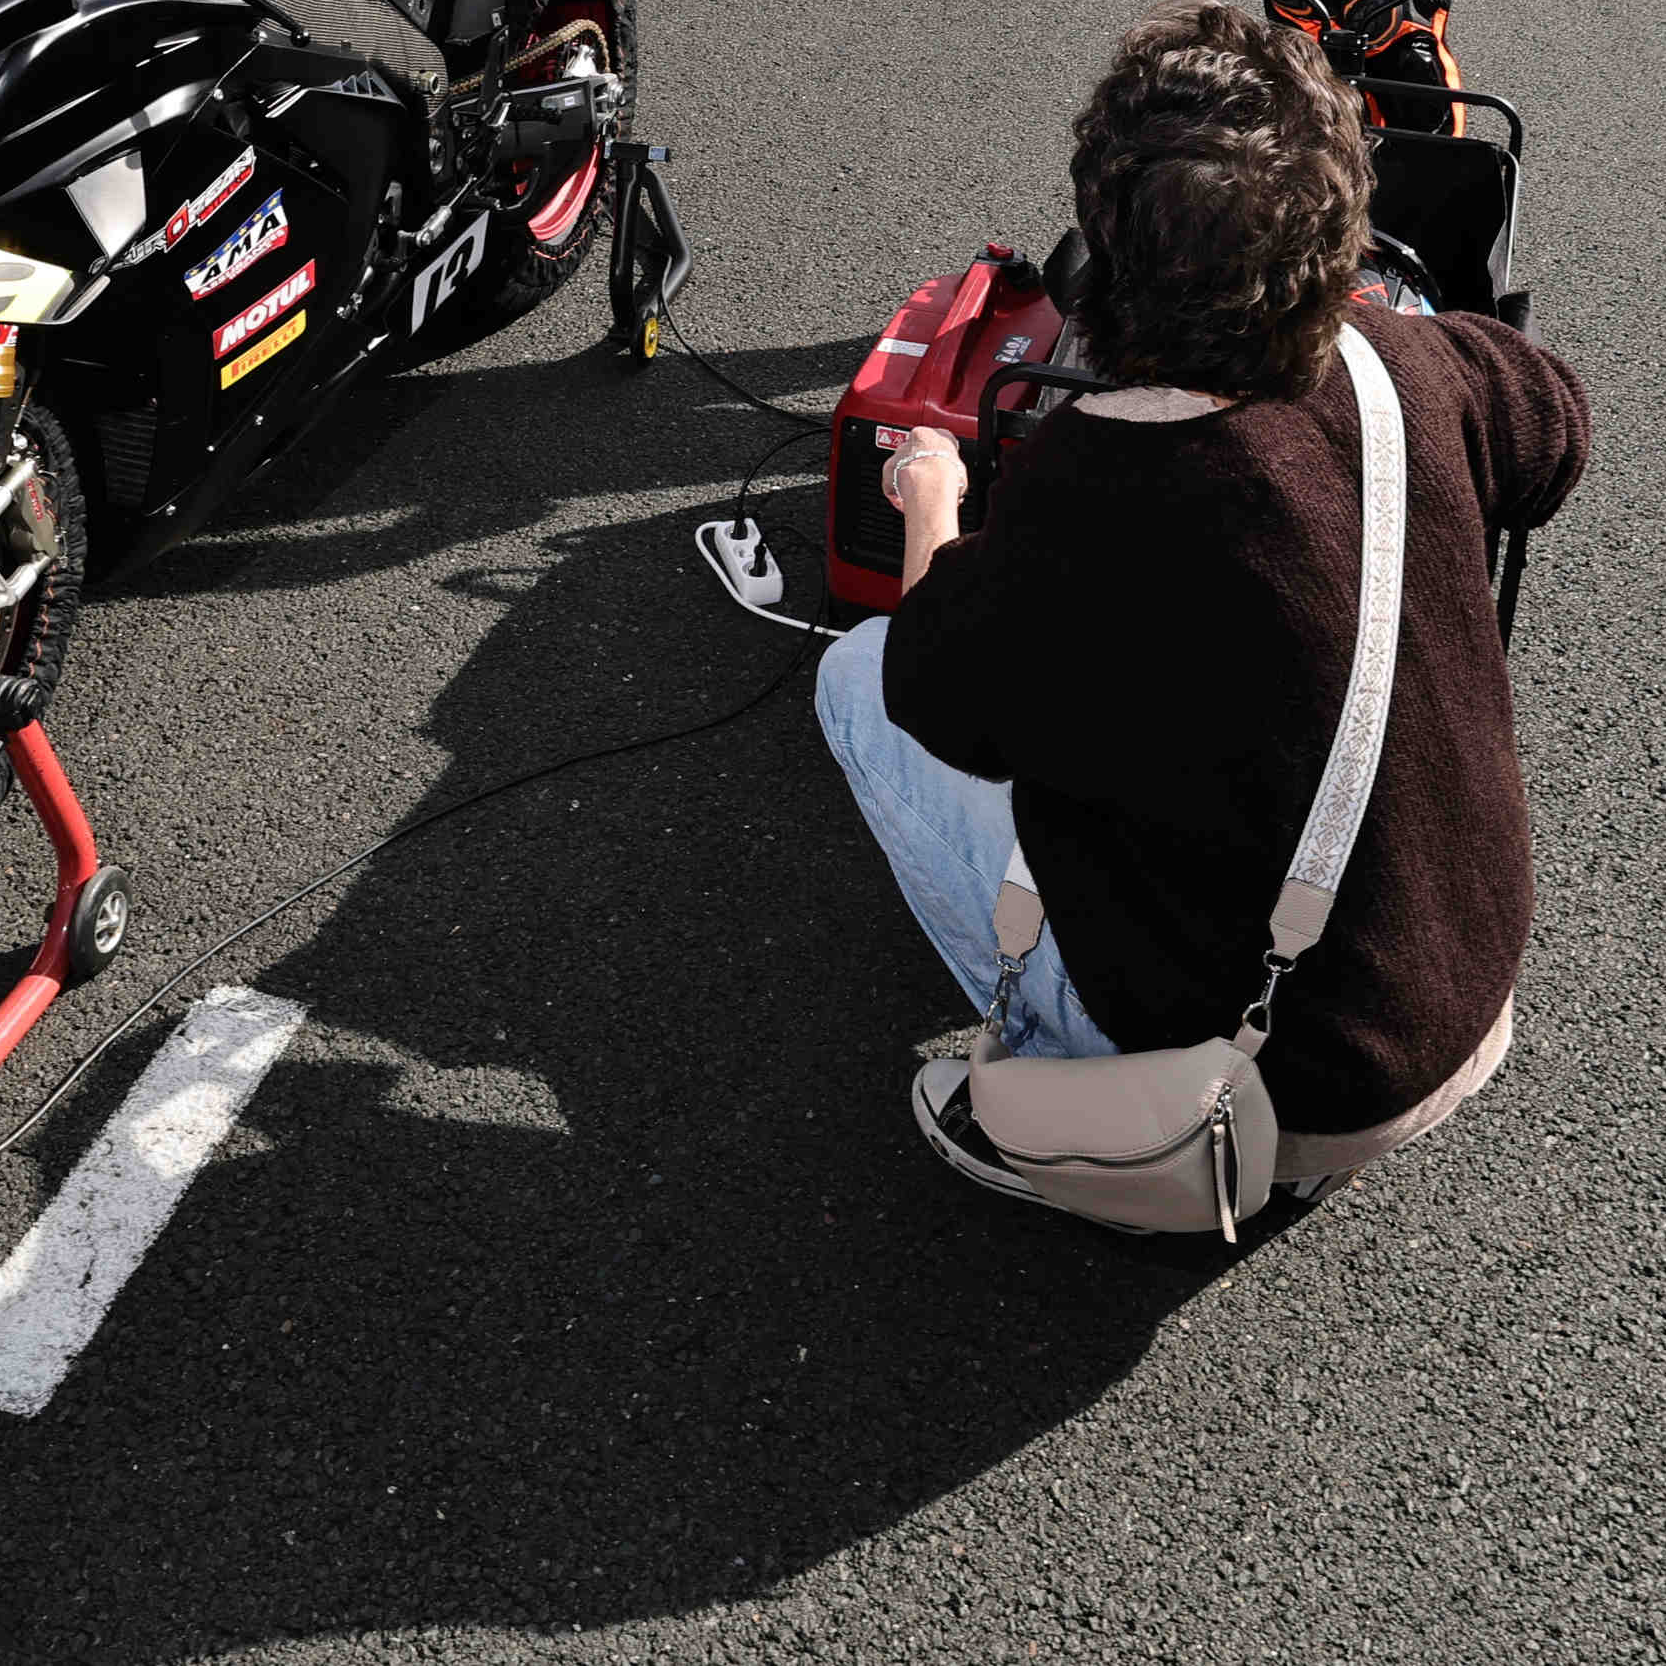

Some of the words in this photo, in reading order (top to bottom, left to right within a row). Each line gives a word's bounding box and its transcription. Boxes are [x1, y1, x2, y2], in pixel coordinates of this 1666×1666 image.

[202, 212, 281, 285] AMA
[218, 269, 312, 353] MOTUL
[230, 318, 298, 378] PIRELLI
